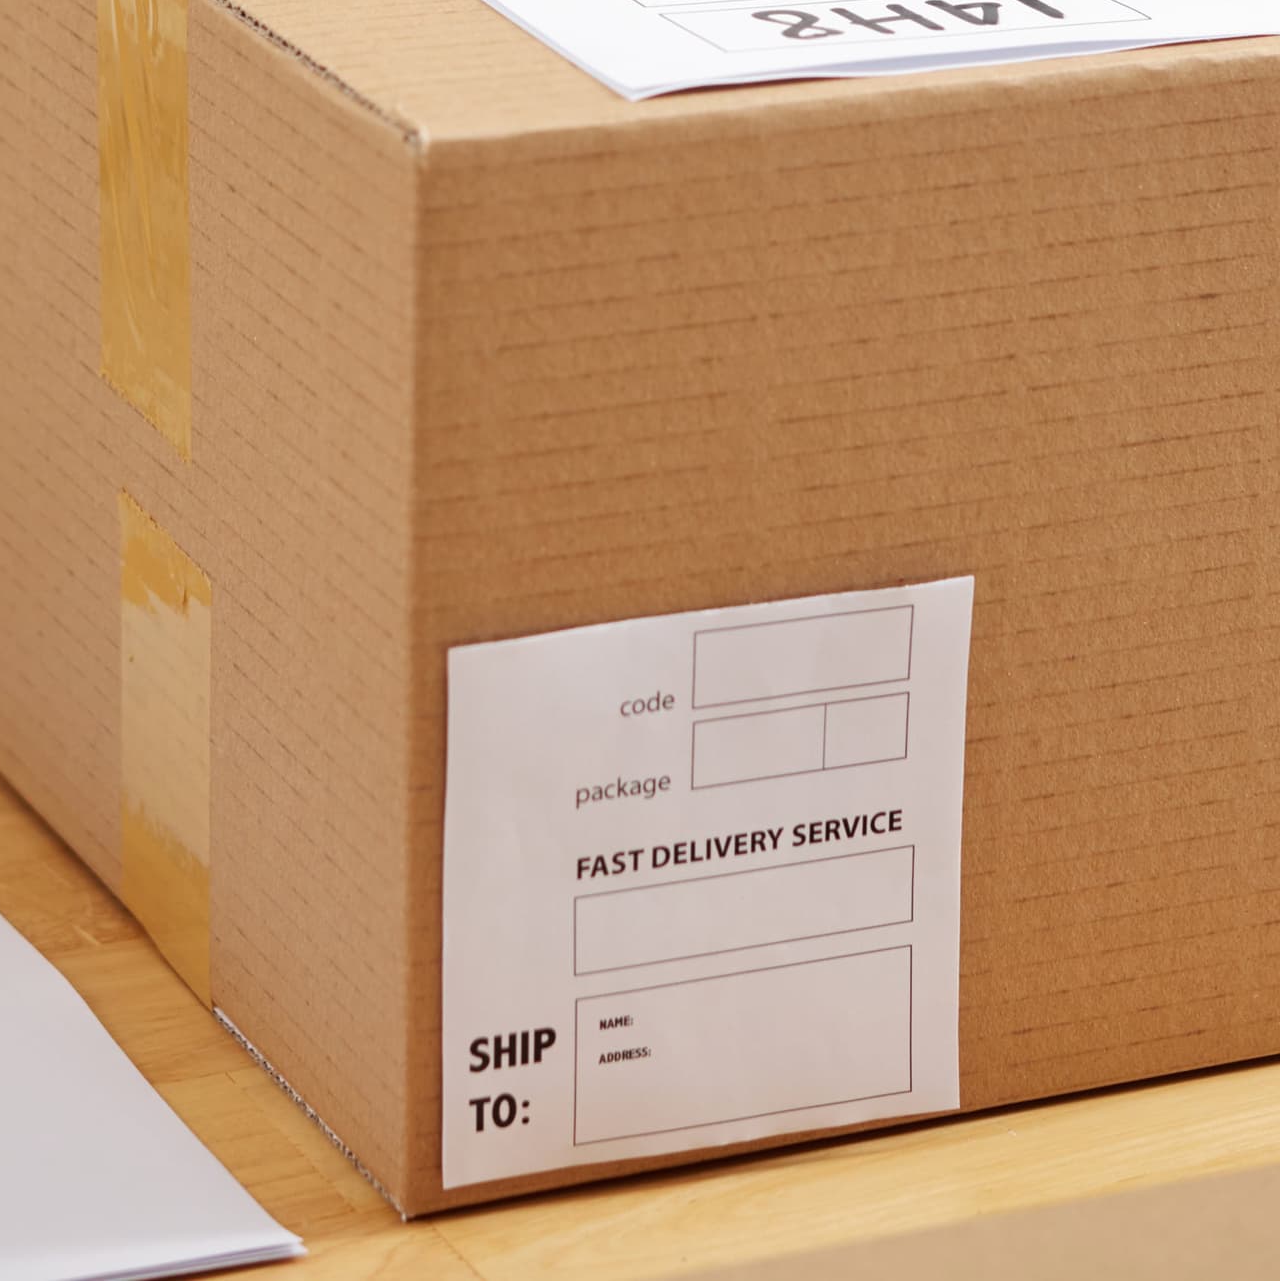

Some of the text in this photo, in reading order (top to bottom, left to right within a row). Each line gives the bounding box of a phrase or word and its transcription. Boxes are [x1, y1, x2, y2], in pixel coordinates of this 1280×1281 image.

[619, 690, 676, 717] code
[575, 773, 671, 809] package
[576, 809, 904, 880] FAST DELIVERY SERVICE
[599, 1015, 634, 1030] NAME:
[468, 1027, 558, 1073] SHIP
[599, 1047, 652, 1065] ADDRESS:
[468, 1094, 532, 1132] TO:
